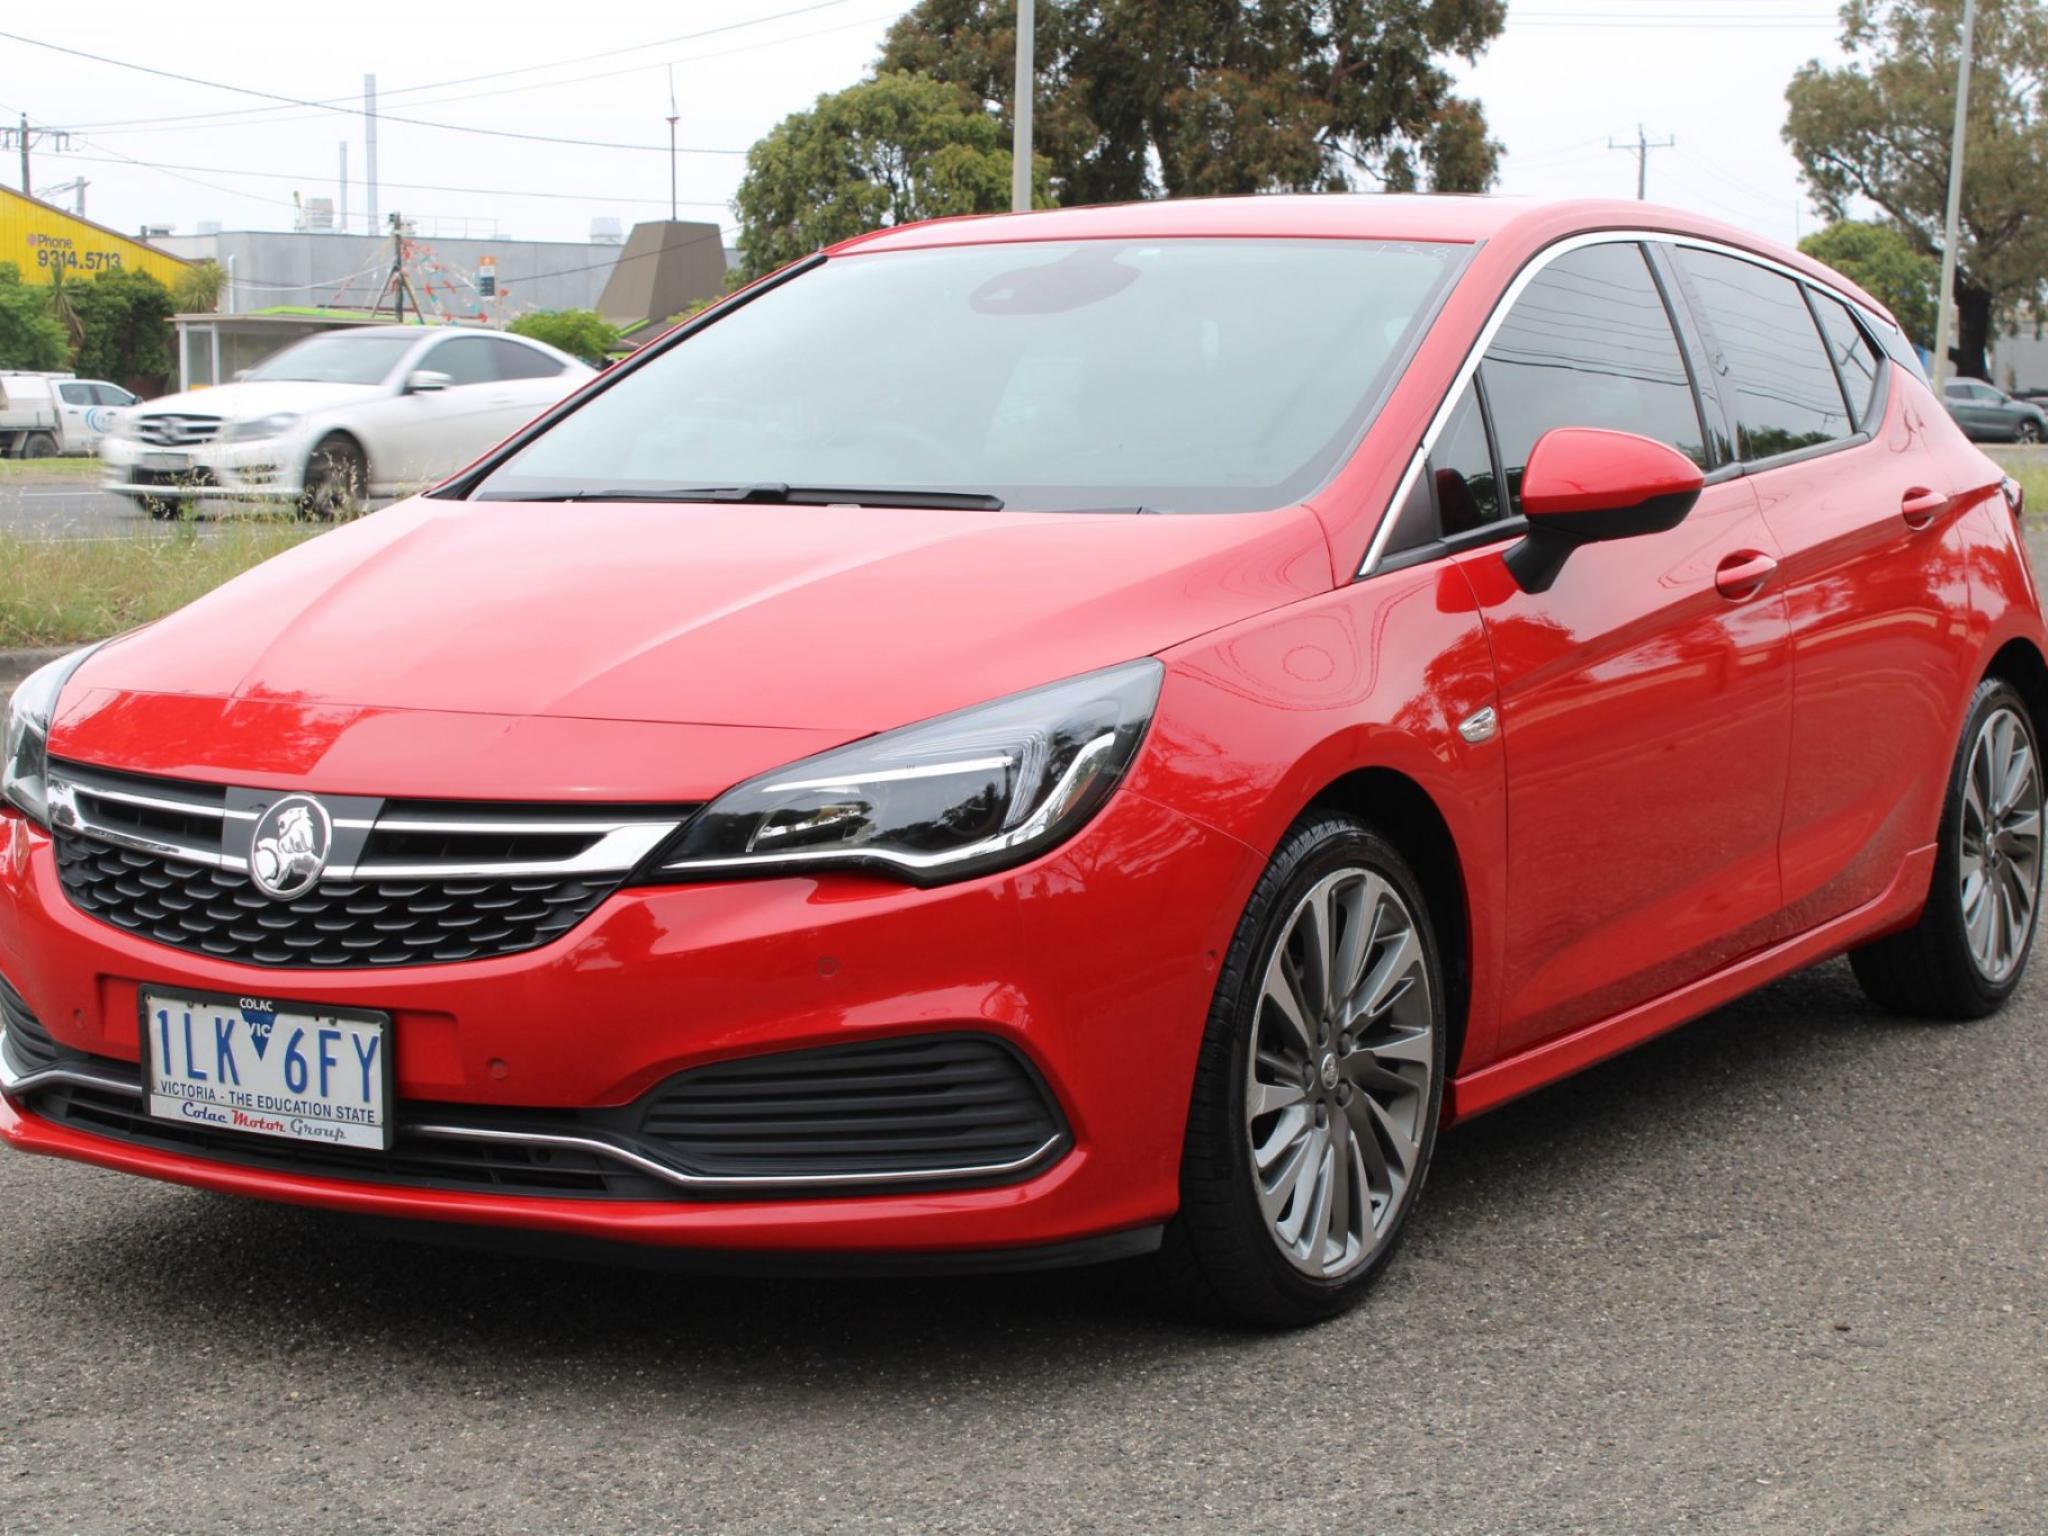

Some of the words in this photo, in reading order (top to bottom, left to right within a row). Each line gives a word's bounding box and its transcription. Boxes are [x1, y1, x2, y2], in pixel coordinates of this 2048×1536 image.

[37, 233, 72, 249] Phone
[239, 998, 273, 1012] COLAC
[248, 1022, 272, 1038] VIC
[157, 1009, 240, 1086] 1LK
[284, 1028, 379, 1103] 6FY
[160, 1079, 215, 1102] VICTORIA
[229, 1091, 252, 1108] THE
[257, 1096, 332, 1118] EDUCATION
[336, 1104, 375, 1123] STATE
[182, 1102, 228, 1124] Colac
[231, 1109, 287, 1133] Motor
[290, 1119, 347, 1141] Group
